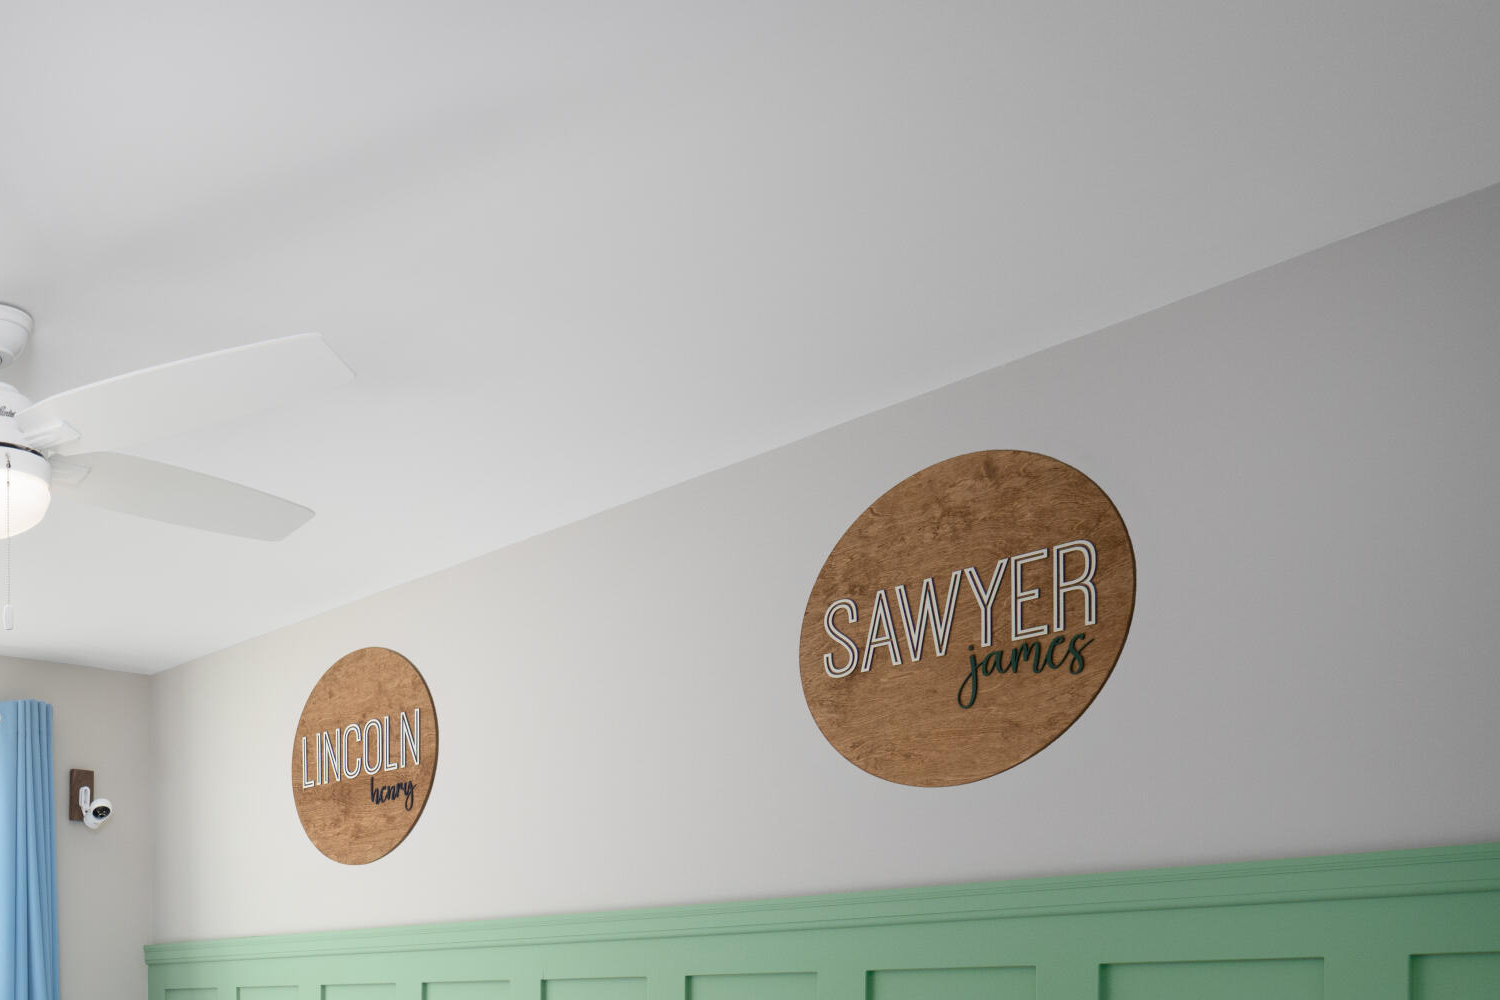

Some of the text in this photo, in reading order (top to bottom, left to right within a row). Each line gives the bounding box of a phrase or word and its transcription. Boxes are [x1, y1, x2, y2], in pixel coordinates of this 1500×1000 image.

[823, 539, 1098, 679] SAWYER
[957, 632, 1096, 710] james
[302, 707, 421, 789] LINCOLN
[369, 776, 417, 812] henry
